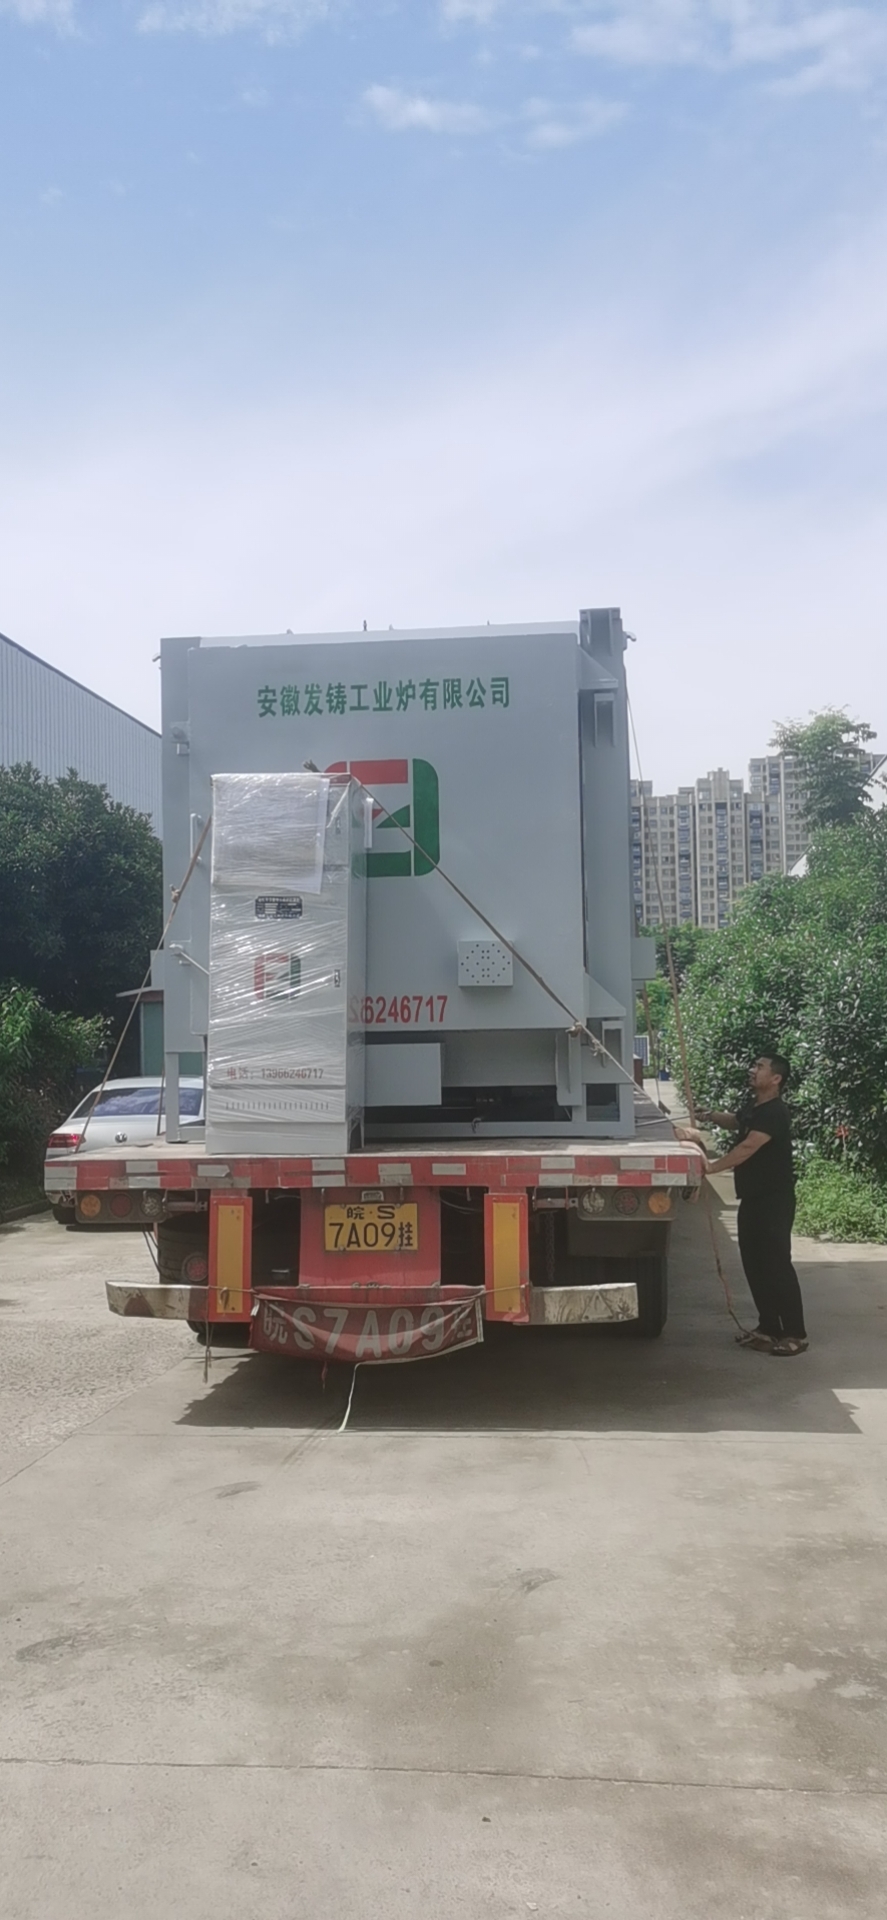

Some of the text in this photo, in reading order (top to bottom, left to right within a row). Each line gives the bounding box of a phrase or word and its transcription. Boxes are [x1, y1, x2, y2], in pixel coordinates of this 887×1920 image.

[257, 676, 511, 718] 安徽发铸工业炉有限公司
[328, 1222, 414, 1248] 7A09挂
